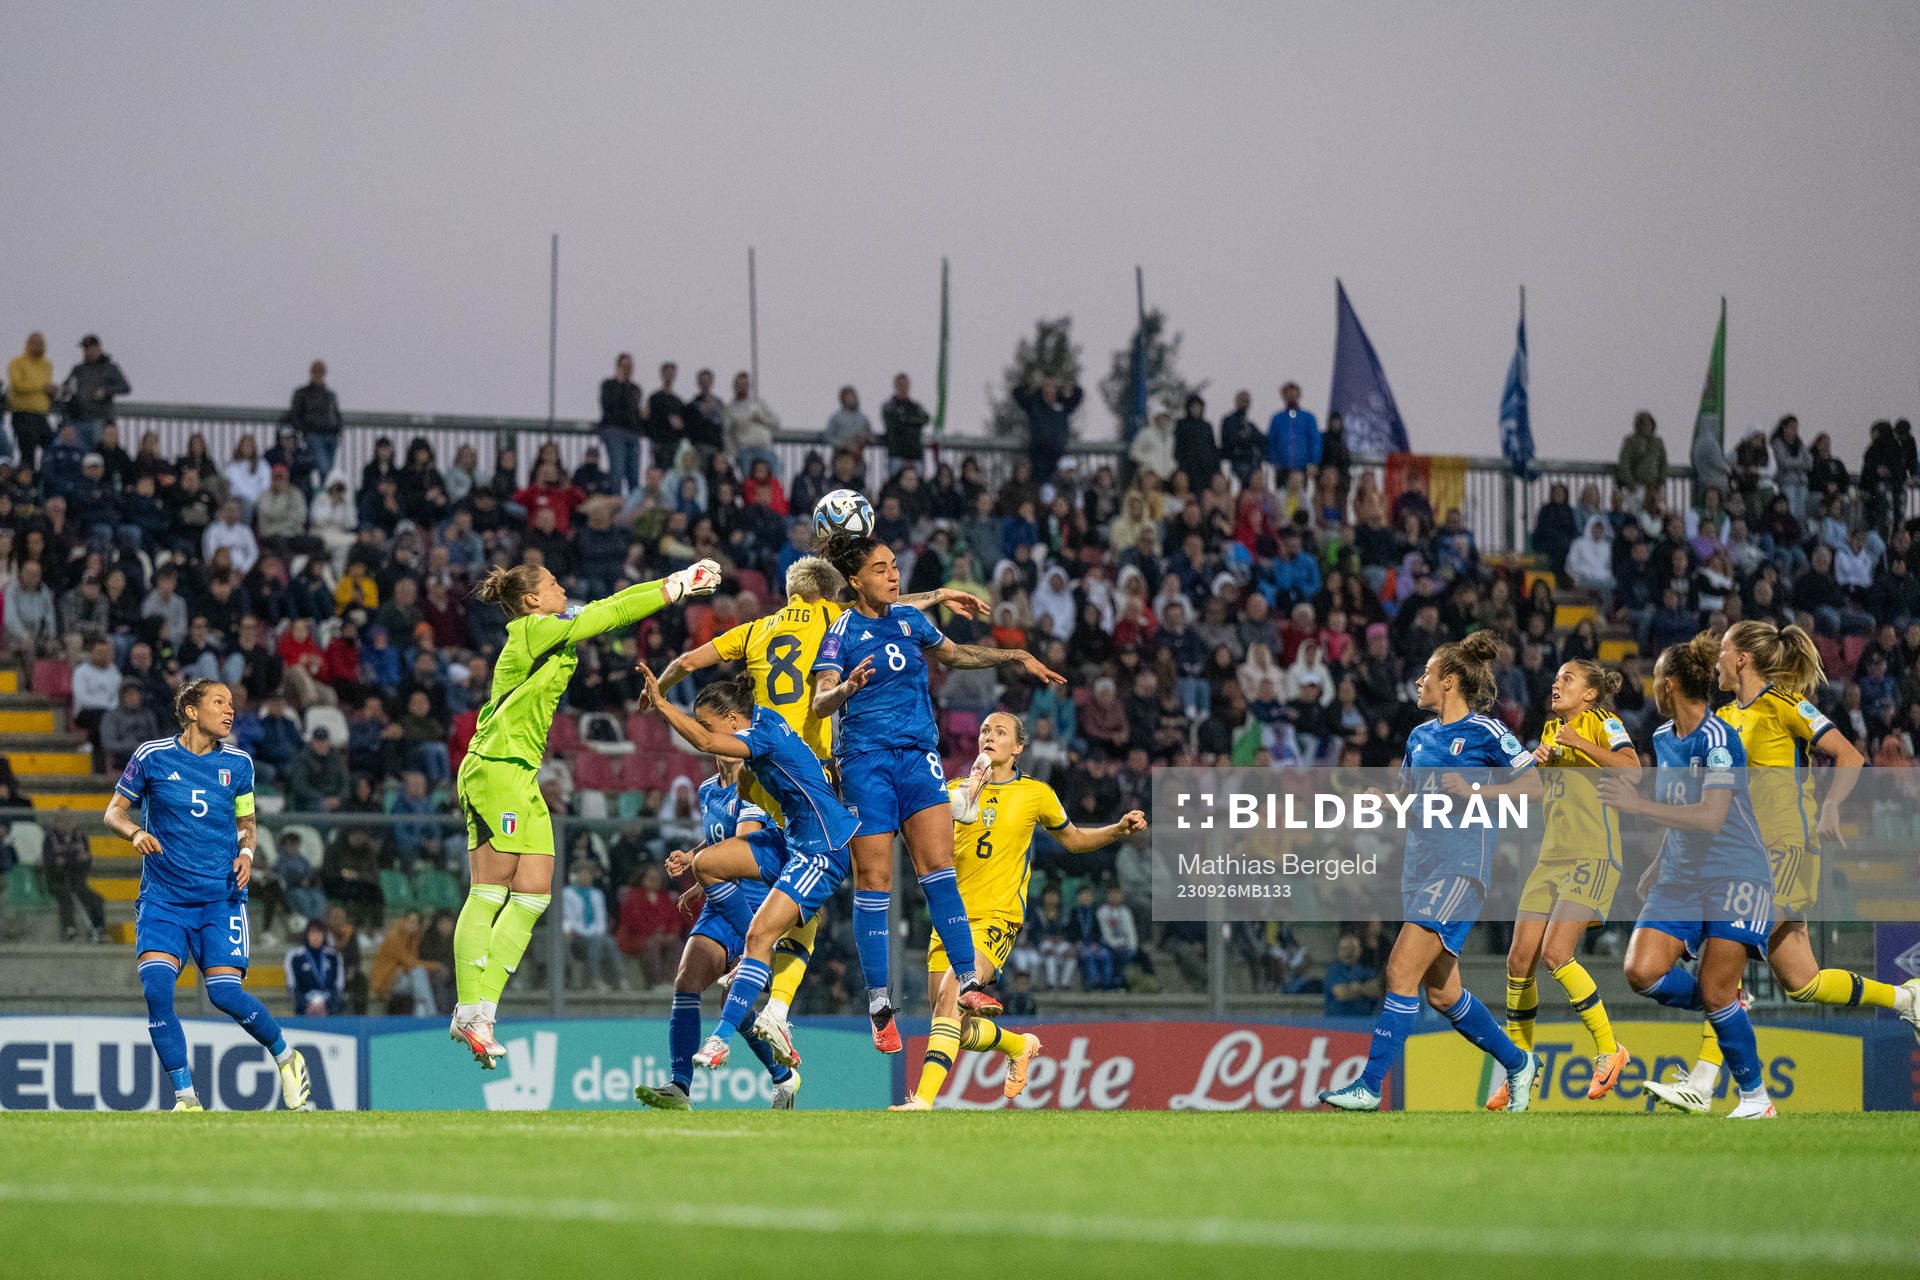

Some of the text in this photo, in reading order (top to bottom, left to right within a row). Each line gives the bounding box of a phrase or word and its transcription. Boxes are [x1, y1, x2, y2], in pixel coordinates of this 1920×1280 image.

[767, 634, 804, 706] 8
[885, 643, 906, 671] 8
[926, 752, 944, 780] 8
[1422, 771, 1438, 795] 4
[190, 789, 208, 818] 5
[710, 822, 725, 845] 19
[976, 831, 993, 859] 6
[1423, 878, 1443, 906] 4
[1722, 881, 1754, 916] 18
[229, 916, 242, 945] 5
[1534, 1043, 1796, 1112] Teeps
